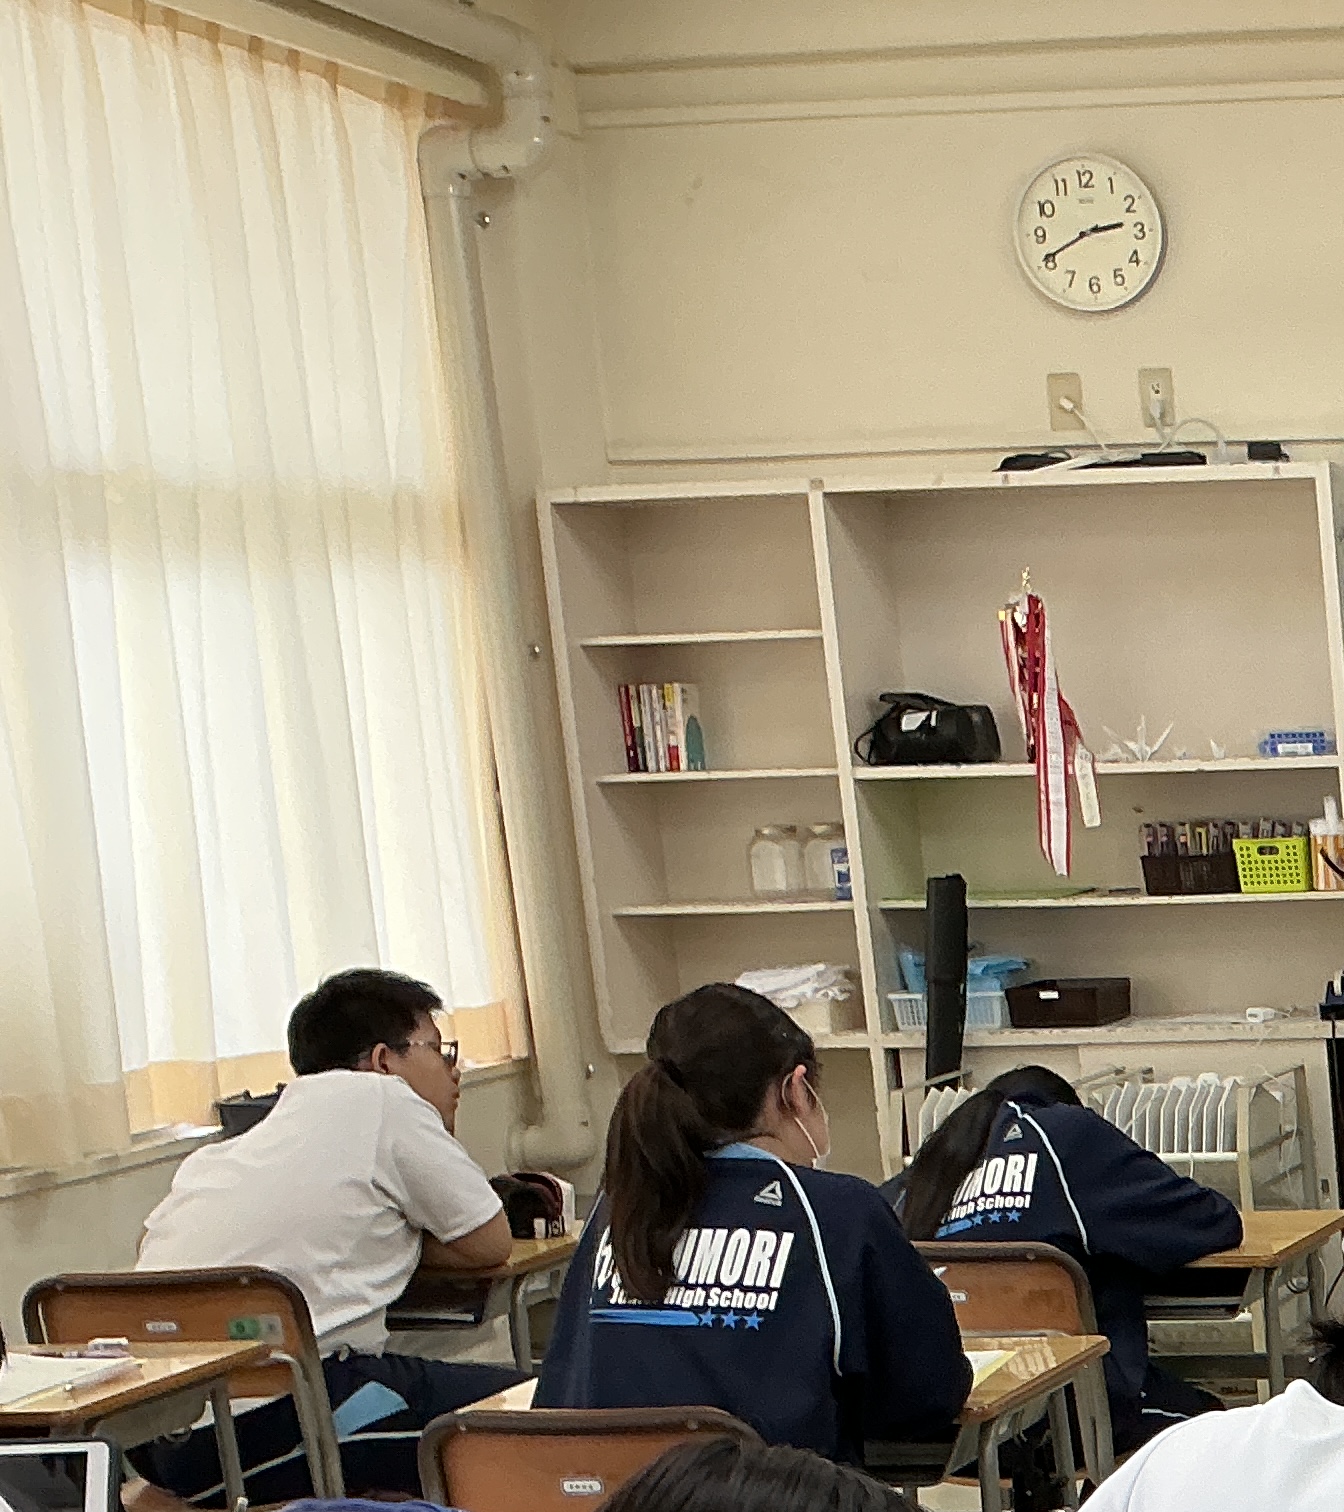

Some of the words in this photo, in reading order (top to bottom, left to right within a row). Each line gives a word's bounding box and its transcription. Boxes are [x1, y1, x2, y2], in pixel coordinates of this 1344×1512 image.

[1054, 178, 1067, 196] 11
[1076, 169, 1094, 188] 12
[1108, 176, 1114, 194] 1
[1038, 199, 1055, 218] 10
[1124, 195, 1136, 213] 2
[1034, 226, 1046, 244] 9
[1133, 222, 1146, 240] 3
[1044, 252, 1057, 271] 8
[1128, 250, 1140, 267] 4
[1065, 270, 1076, 288] 7
[1089, 276, 1100, 294] 6
[1113, 268, 1125, 286] 5
[977, 1194, 1031, 1212] School
[707, 1287, 778, 1311] School
